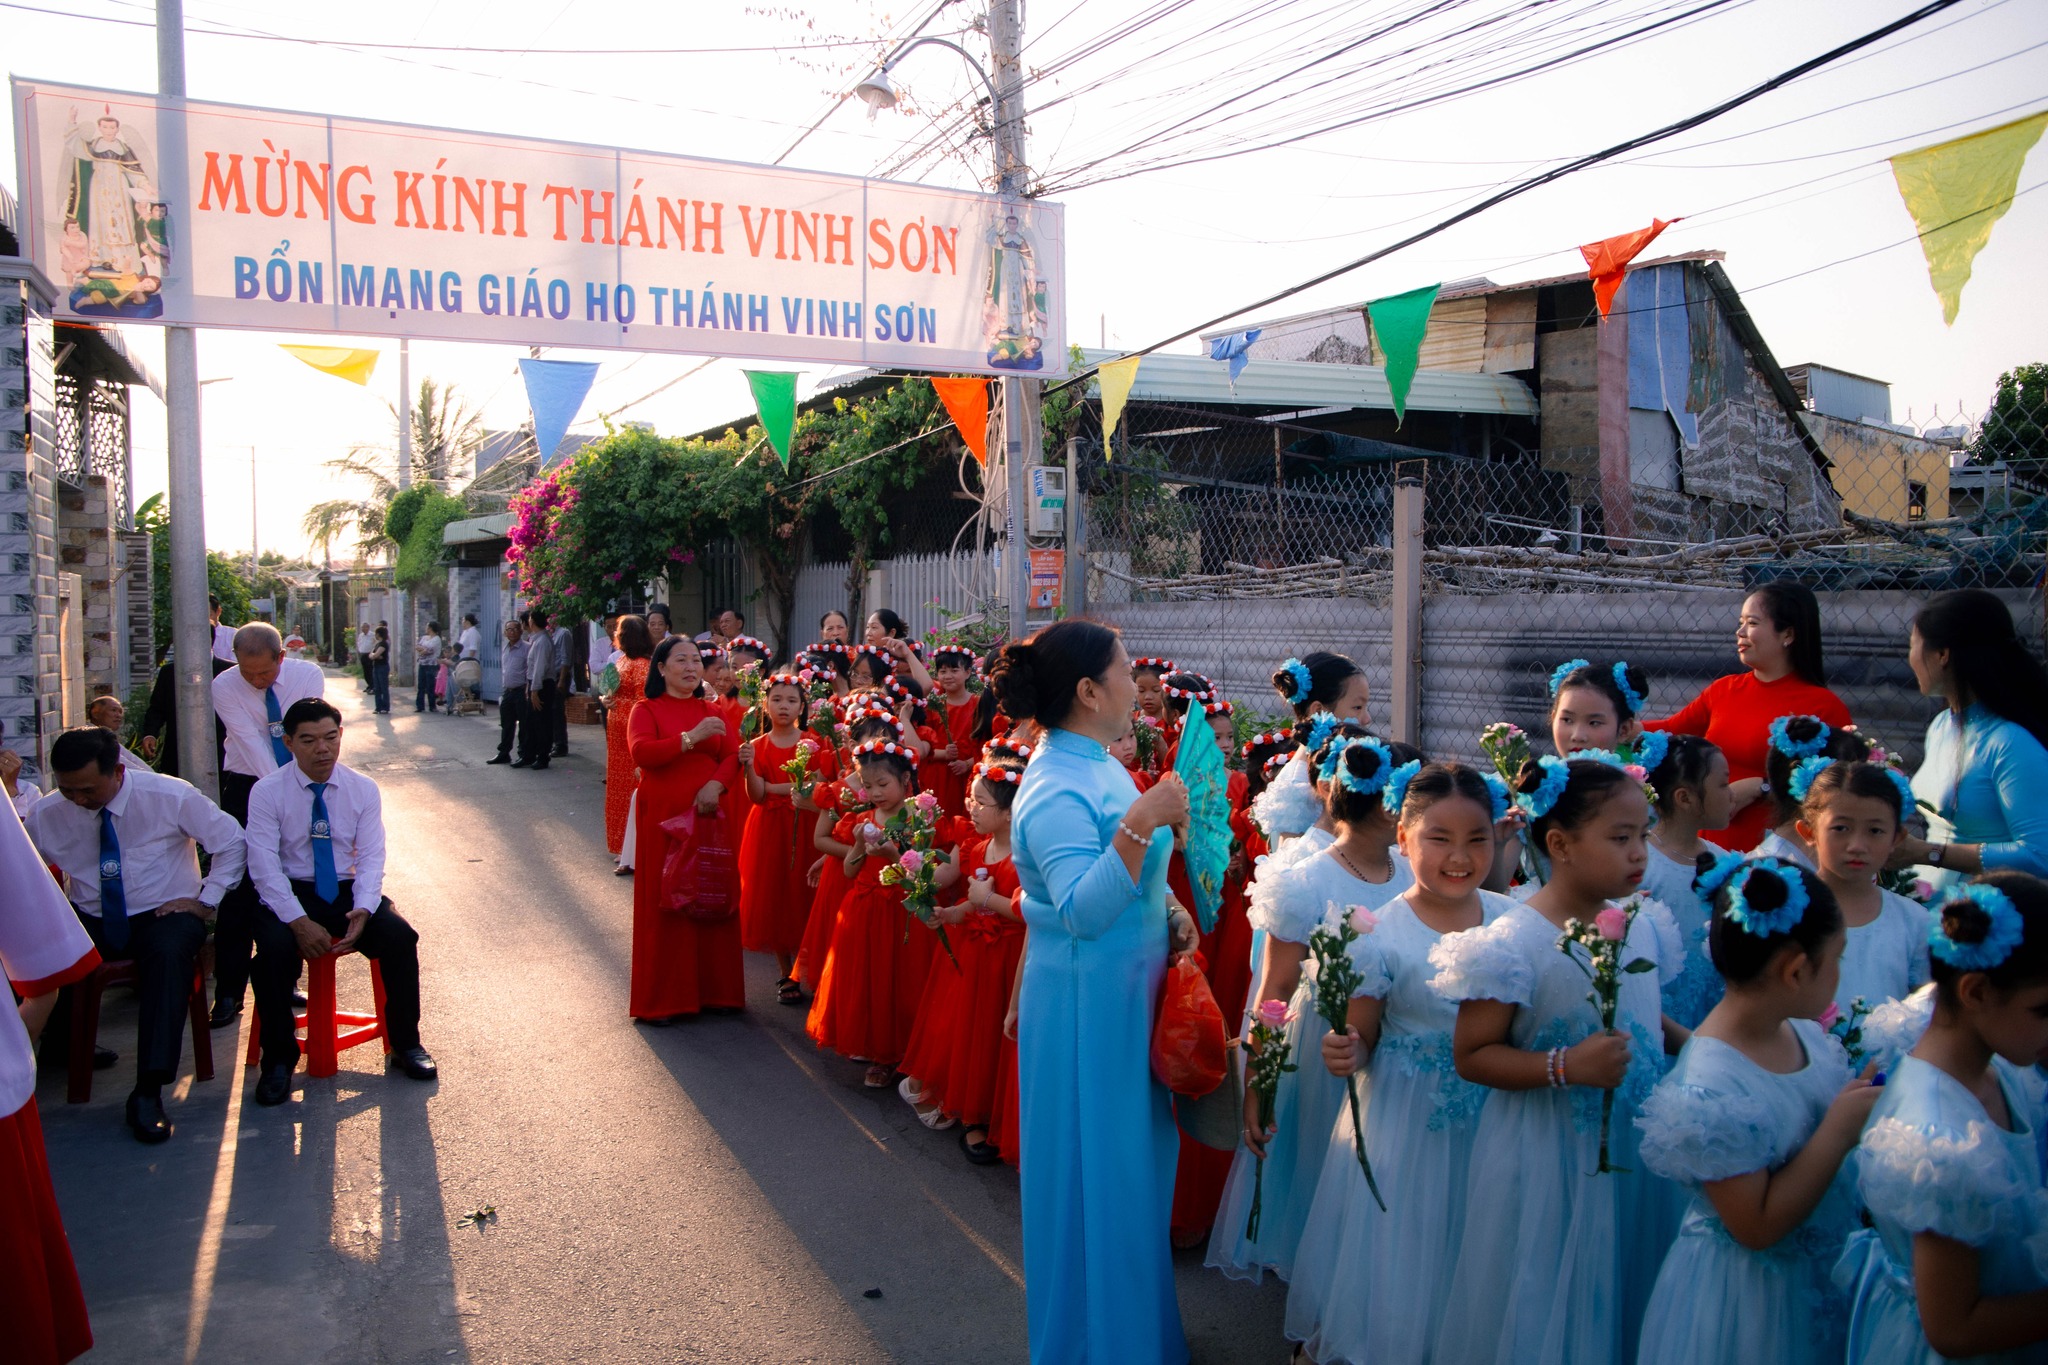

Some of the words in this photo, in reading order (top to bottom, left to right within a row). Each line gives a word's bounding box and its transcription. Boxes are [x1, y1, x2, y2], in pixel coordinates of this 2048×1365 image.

[198, 139, 376, 224] MỪNG
[393, 158, 527, 237] KÍNH
[542, 178, 724, 254] THÁNH
[738, 204, 853, 265] VINH
[868, 216, 958, 275] SƠN
[235, 239, 323, 304] BỔN
[341, 264, 463, 319] MẠNG
[479, 268, 570, 319] GIÁO
[586, 281, 635, 333] HỌ
[649, 281, 768, 332] THÁNH
[781, 297, 862, 339] VINH
[874, 301, 937, 344] SƠN
